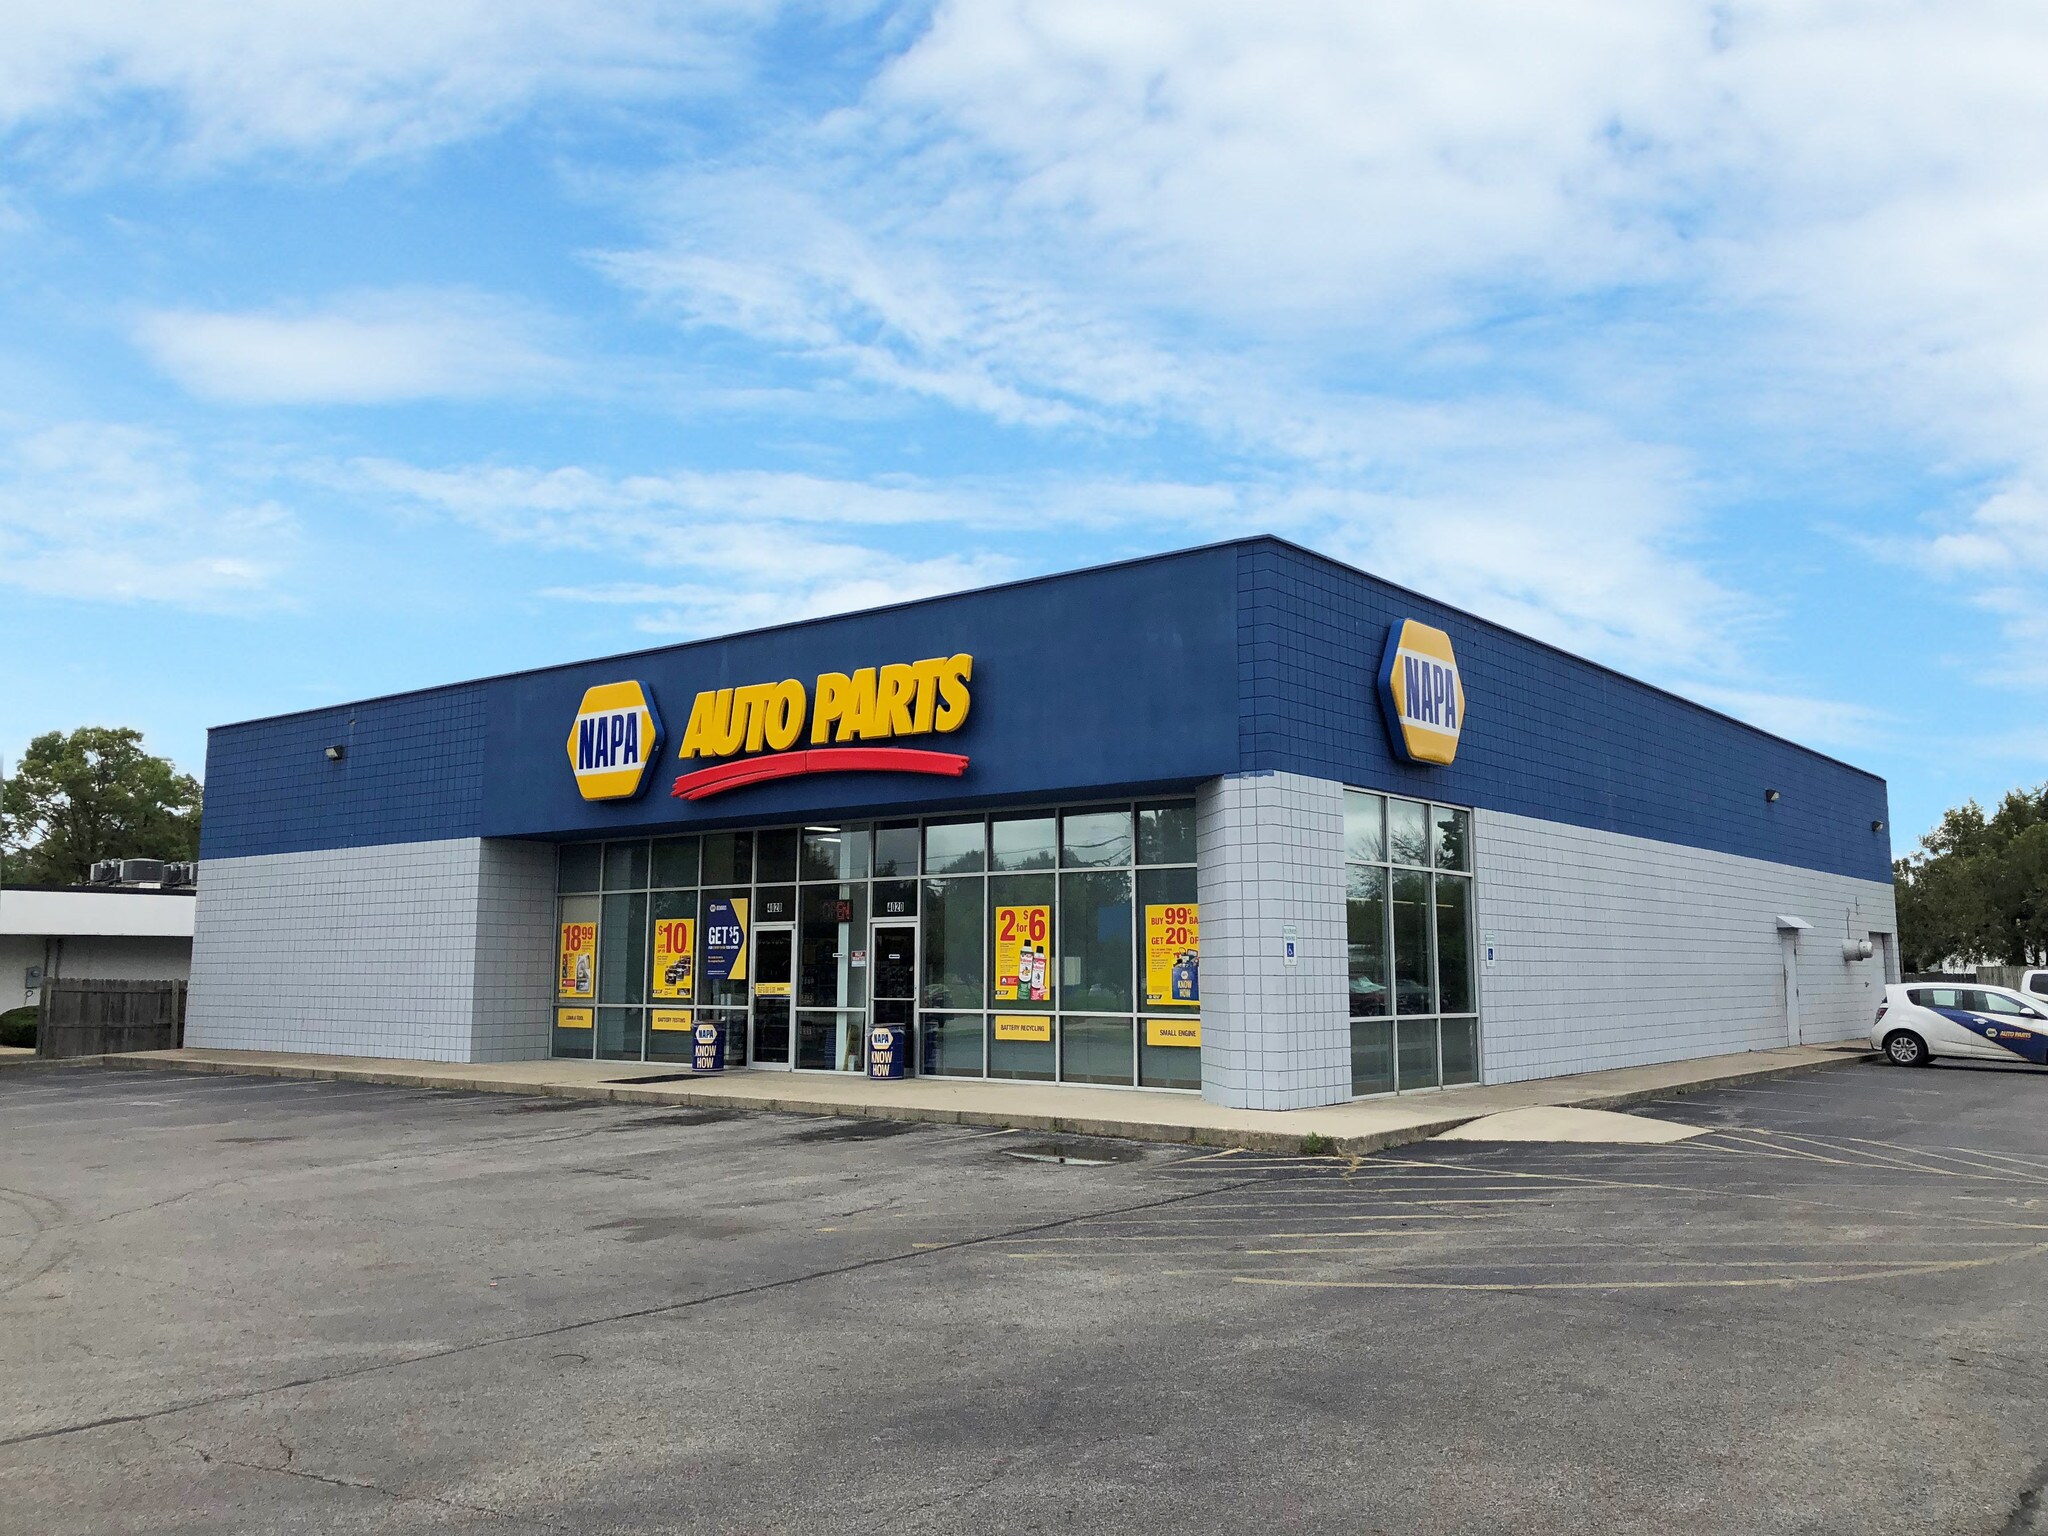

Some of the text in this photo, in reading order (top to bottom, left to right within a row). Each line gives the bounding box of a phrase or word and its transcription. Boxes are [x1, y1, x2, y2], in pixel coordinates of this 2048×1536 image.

[1404, 656, 1456, 729] NAPA
[678, 653, 974, 760] AUTO PARTS
[578, 712, 638, 770] NAPA
[767, 903, 783, 913] 4020
[887, 902, 905, 912] 4020
[1000, 909, 1016, 942] 2
[1016, 923, 1028, 933] for
[1151, 918, 1164, 926] BUY
[1189, 916, 1199, 925] BA
[708, 926, 740, 945] GET $5
[1151, 926, 1199, 945] GET 20% OF
[698, 1029, 714, 1039] NAPA
[1020, 1024, 1045, 1032] RECYCLING
[1160, 1029, 1196, 1037] SMALL ENGINE
[873, 1033, 890, 1044] NAPA
[2000, 1030, 2015, 1038] AUTO
[2014, 1031, 2032, 1039] PARTS
[695, 1045, 717, 1057] KNOW
[871, 1050, 893, 1064] KNOW
[696, 1057, 714, 1069] HOW
[872, 1063, 890, 1077] HOW
